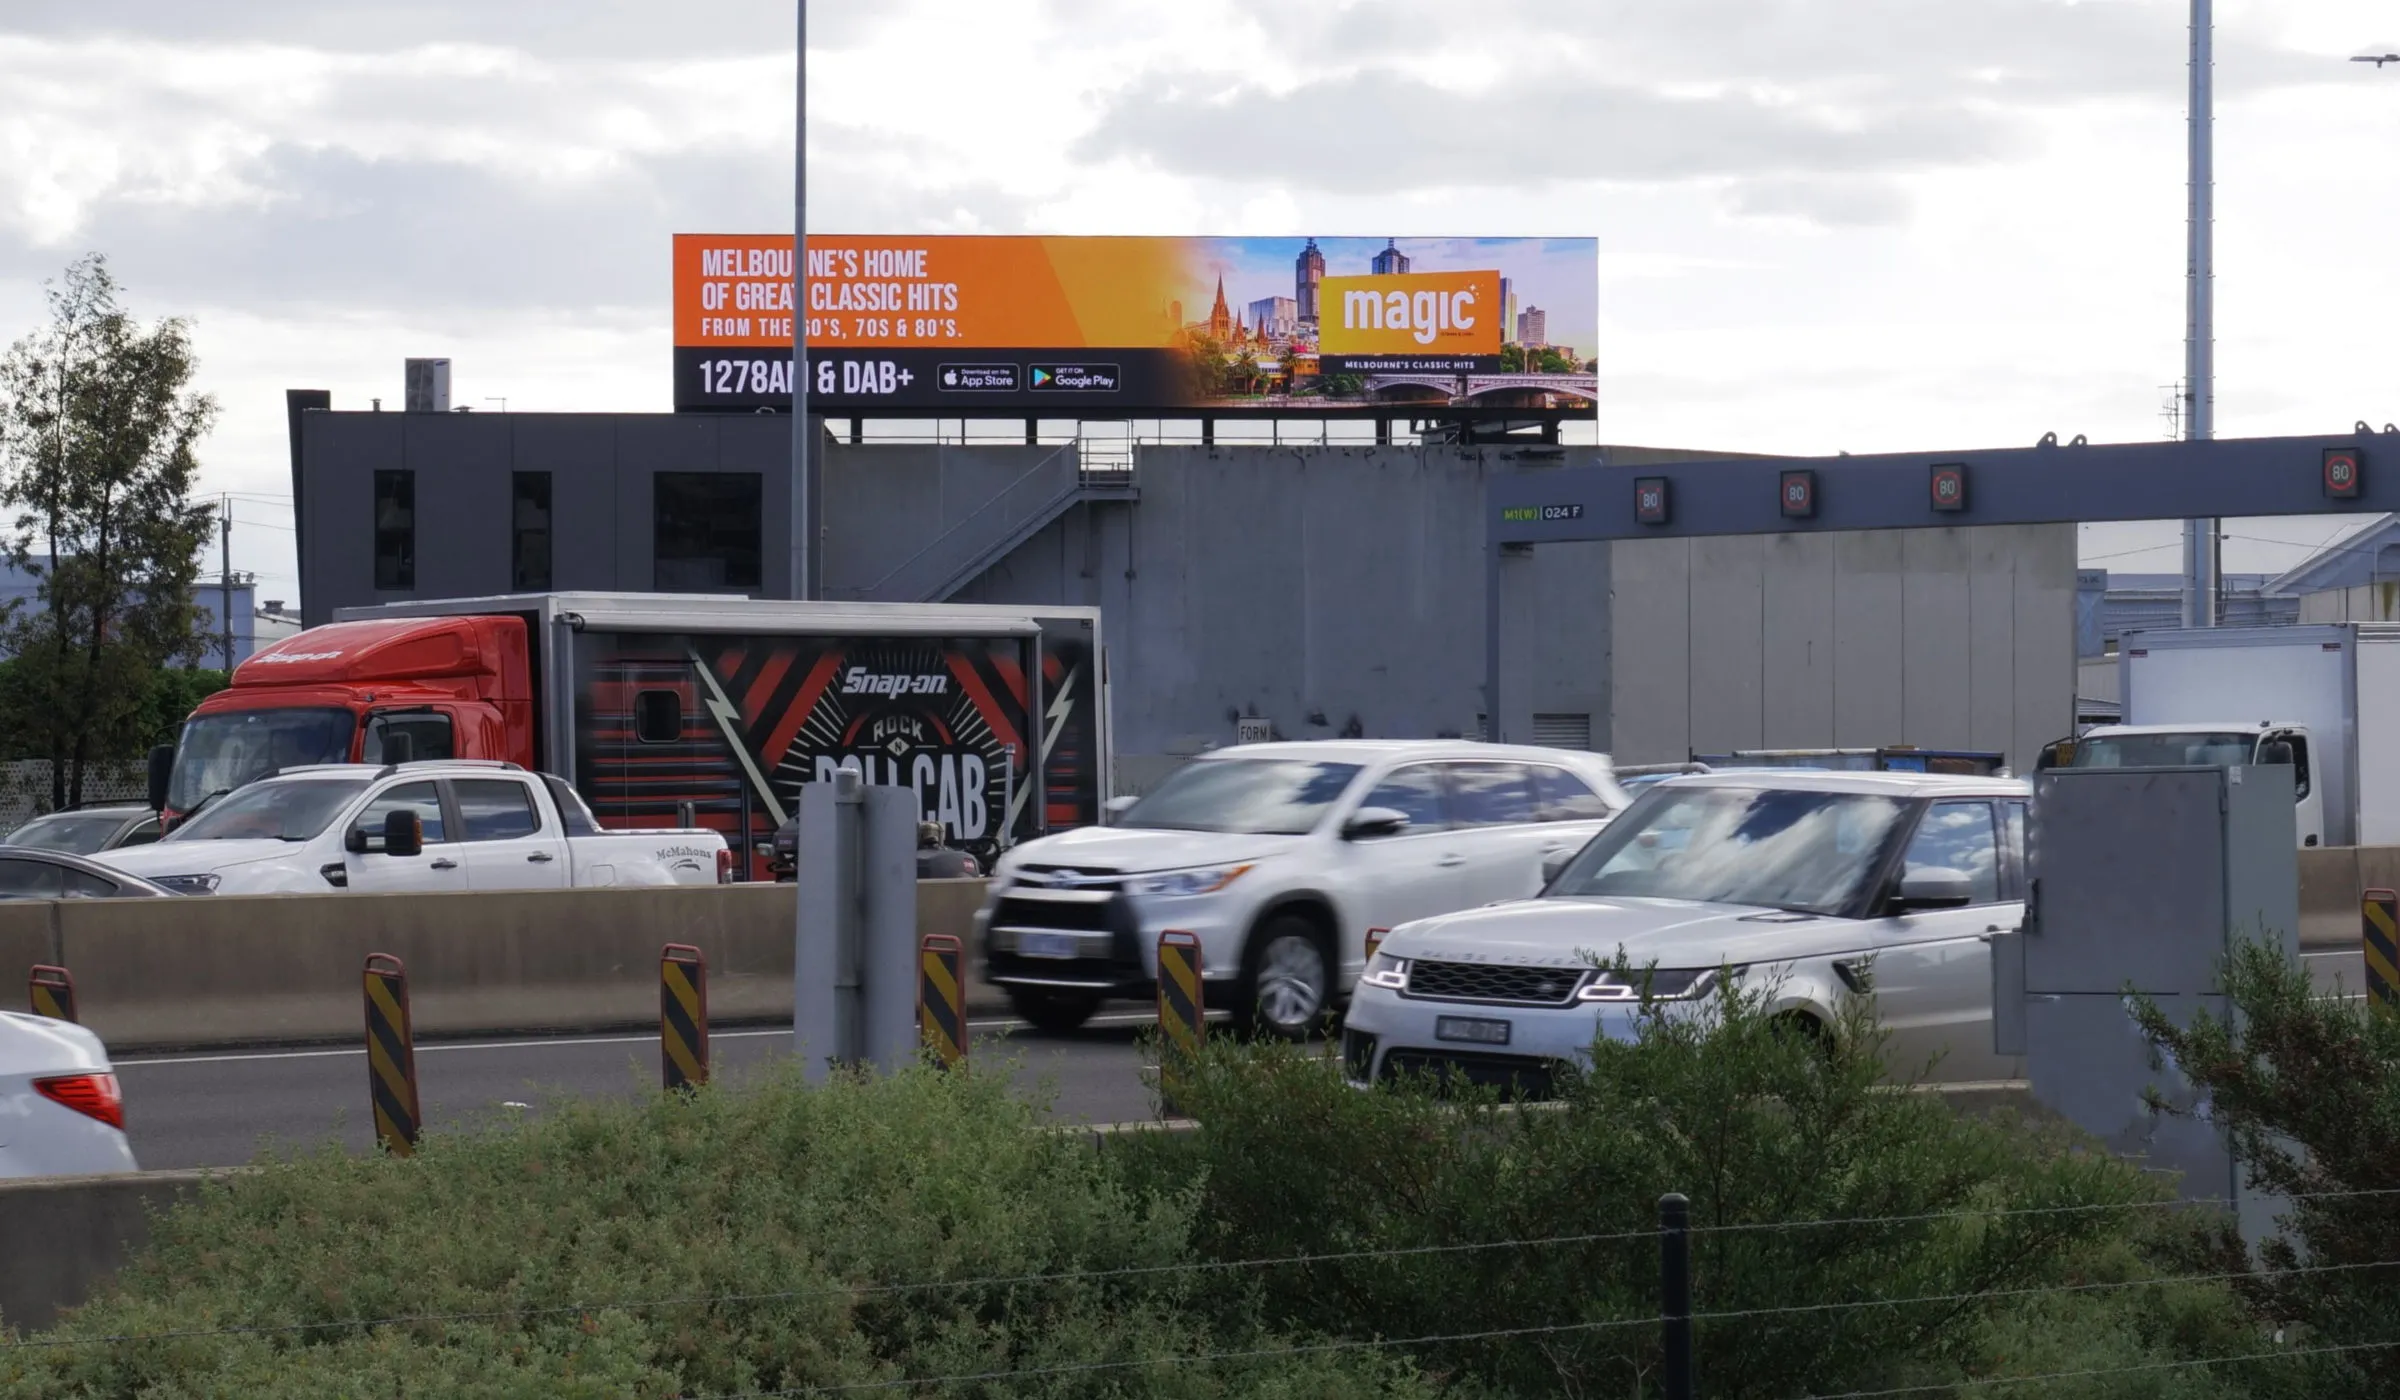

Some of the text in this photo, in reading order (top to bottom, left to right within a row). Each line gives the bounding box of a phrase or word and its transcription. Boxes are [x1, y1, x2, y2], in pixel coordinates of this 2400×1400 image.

[702, 249, 928, 278] MELBOUNE'S HOME
[702, 282, 958, 311] OF GREA CLASSIC HITS
[1344, 290, 1476, 344] magic
[702, 318, 751, 337] FROM
[759, 318, 792, 337] THE
[856, 318, 889, 337] 70S
[897, 318, 907, 337] &
[915, 318, 962, 338] 80'S.
[1345, 361, 1475, 369] MELBOURNE'S CLASSIC HITS
[818, 360, 836, 393] &
[843, 361, 914, 393] DAB+
[961, 375, 1014, 387] App Store
[1056, 374, 1114, 388] Google Play
[2332, 464, 2349, 480] 80
[1788, 486, 1804, 501] 80
[1939, 479, 1956, 496] 80
[1643, 493, 1658, 507] 80
[1544, 506, 1568, 518] 024
[1572, 505, 1580, 517] F
[841, 666, 947, 700] Snap-on
[873, 715, 924, 743] ROCK
[1240, 725, 1268, 740] FORM
[912, 753, 987, 840] CAB
[656, 846, 712, 861] McMahons
